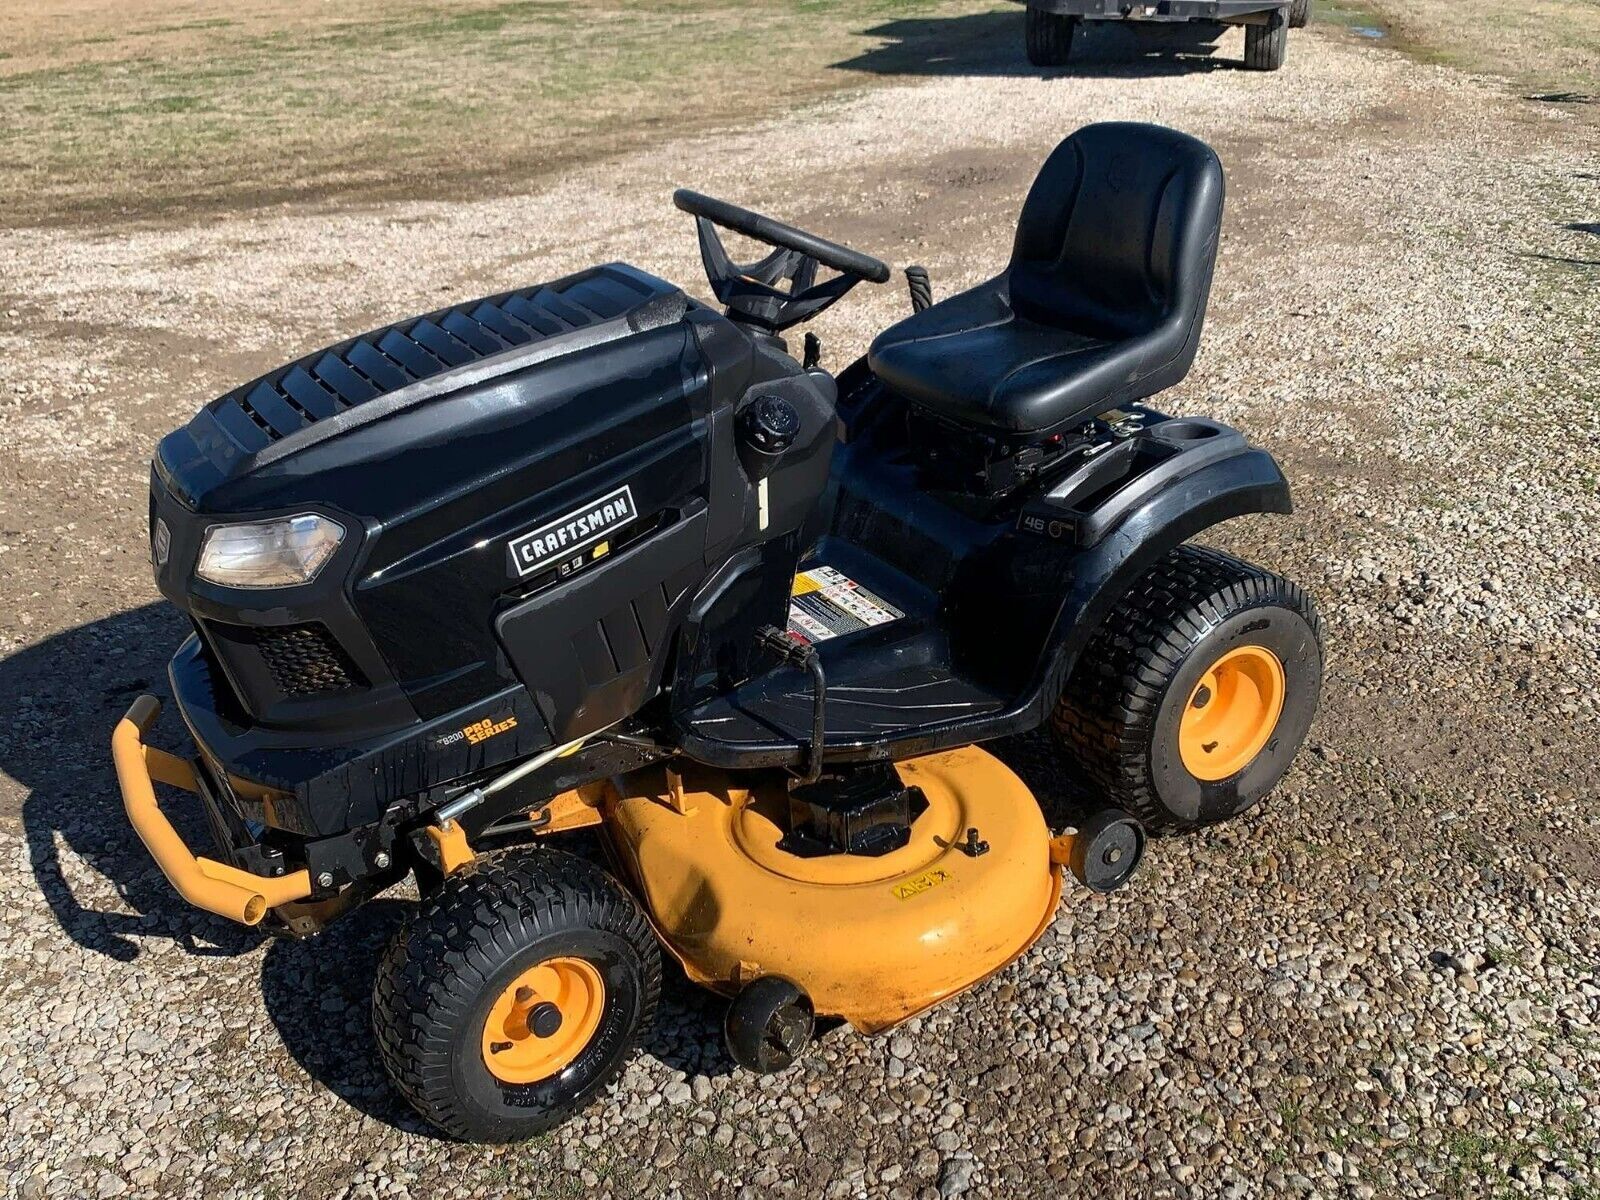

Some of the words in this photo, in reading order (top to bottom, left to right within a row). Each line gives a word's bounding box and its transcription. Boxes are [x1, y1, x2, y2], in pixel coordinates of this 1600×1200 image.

[520, 497, 629, 563] CRAFTSMAN
[1024, 516, 1045, 531] 46
[463, 718, 492, 737] PRO
[467, 716, 518, 745] SERIES
